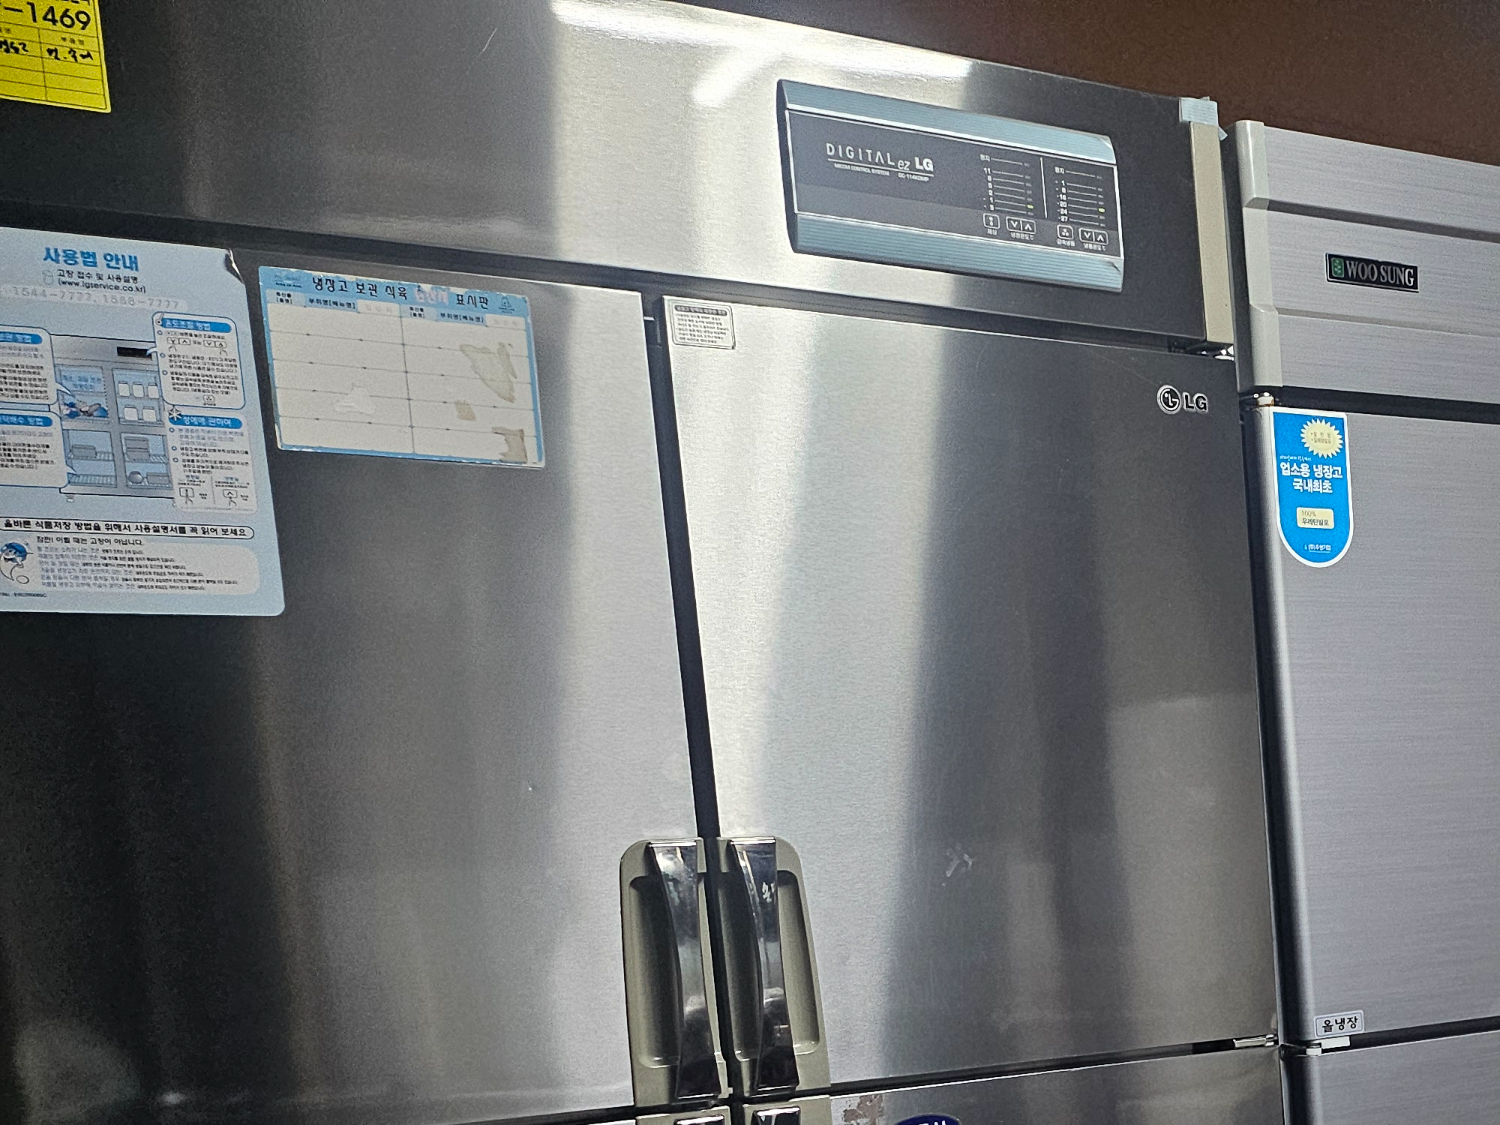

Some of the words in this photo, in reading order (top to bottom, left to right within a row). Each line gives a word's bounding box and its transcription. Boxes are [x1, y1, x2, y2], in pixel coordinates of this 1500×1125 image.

[826, 142, 895, 166] DIGITAL
[898, 159, 911, 171] ez
[914, 156, 934, 172] LG
[43, 247, 98, 267] 사용법
[103, 252, 139, 271] 안내
[1345, 260, 1378, 281] WOO
[1380, 264, 1415, 286] SUNG
[312, 276, 349, 293] 냉장고
[356, 282, 378, 298] 보관
[385, 285, 408, 300] 식육
[456, 293, 489, 310] 표시판
[1280, 462, 1310, 478] 업소용
[1313, 464, 1343, 479] 냉장고
[1293, 478, 1334, 494] 국내최초
[4, 519, 31, 529] 올바른
[35, 520, 71, 530] 식품저장
[74, 521, 102, 532] 방법을
[105, 523, 132, 533] 위해서
[134, 524, 187, 535] 사용설명서를
[201, 526, 218, 535] 읽어
[221, 527, 247, 537] 보세요
[1322, 1016, 1358, 1033] 올냉장
